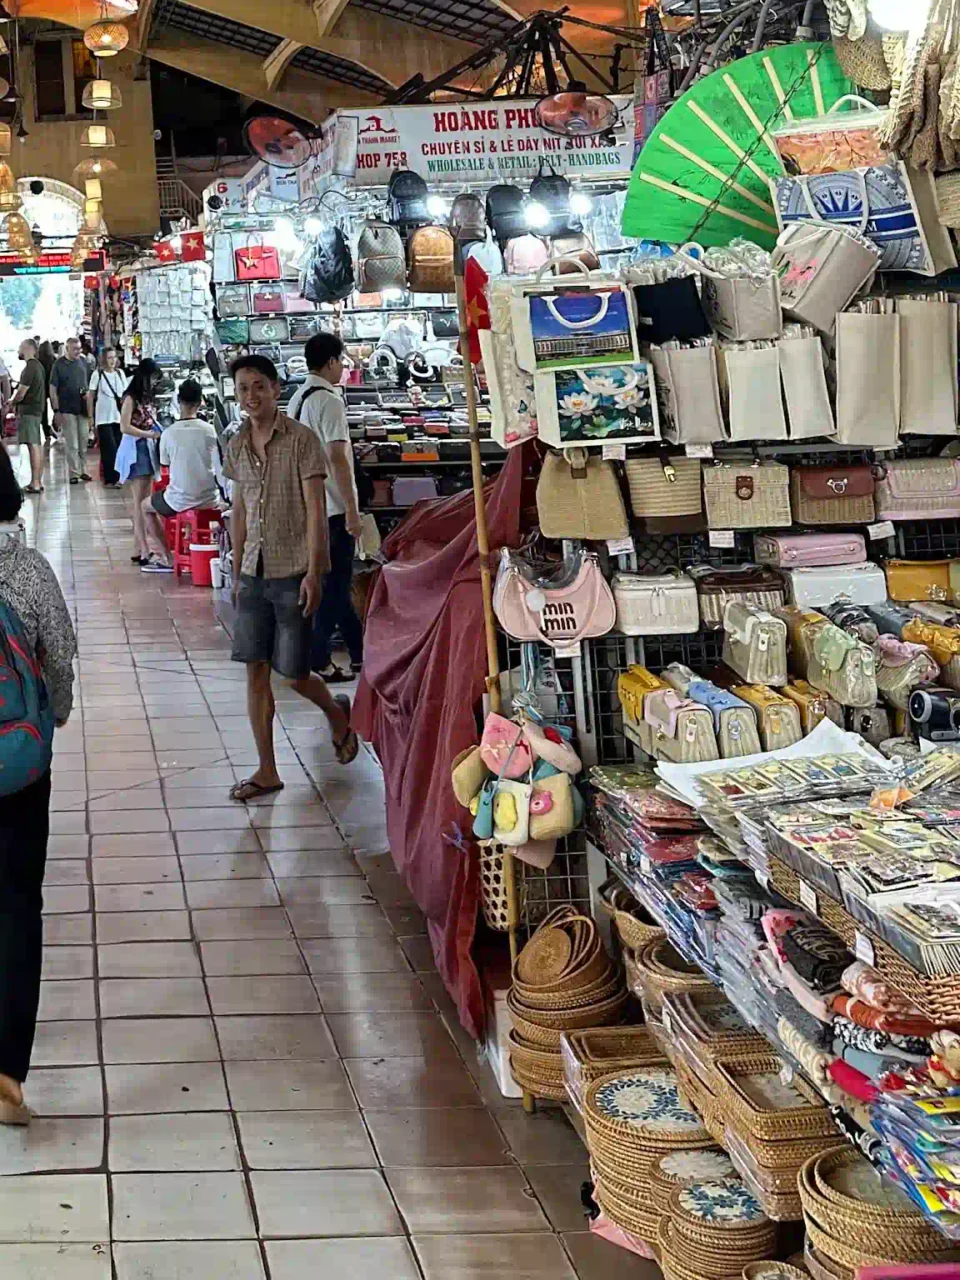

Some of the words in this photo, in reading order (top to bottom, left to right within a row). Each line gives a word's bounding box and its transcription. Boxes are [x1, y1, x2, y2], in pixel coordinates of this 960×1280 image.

[433, 106, 499, 132] HOÀNG
[421, 138, 470, 156] CHUYÊN
[356, 153, 380, 168] HOP
[427, 158, 485, 172] WHOLESALE
[568, 152, 621, 166] HANDBAGS
